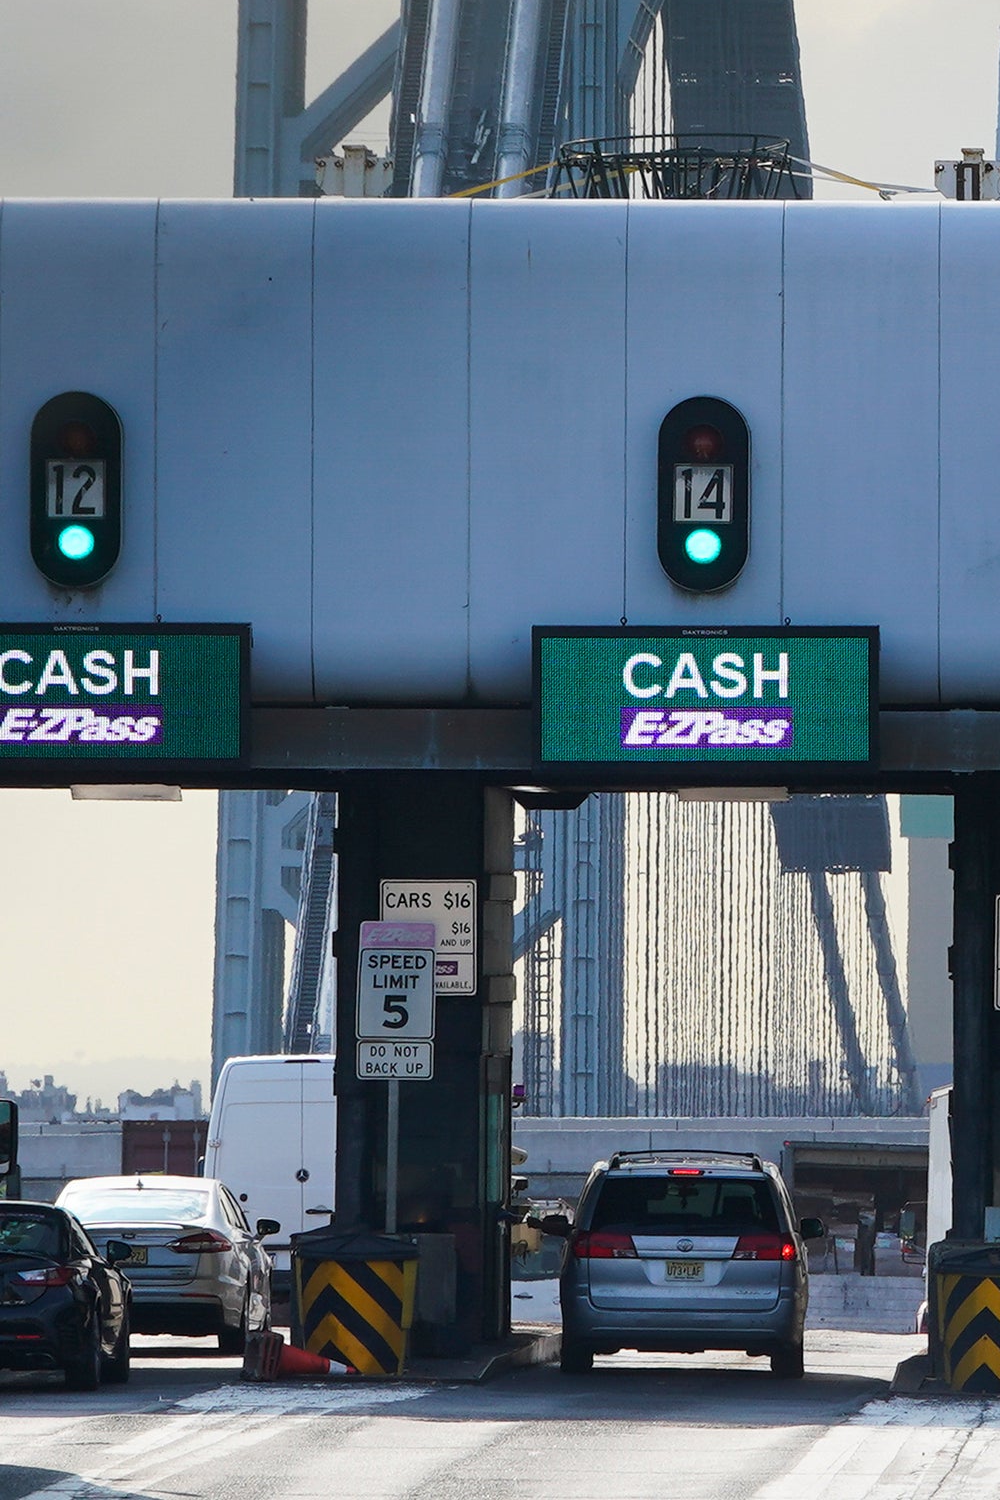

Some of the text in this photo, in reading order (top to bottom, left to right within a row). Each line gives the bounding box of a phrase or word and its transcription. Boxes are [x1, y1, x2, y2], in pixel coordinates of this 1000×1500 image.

[53, 464, 96, 515] 12
[681, 468, 725, 519] 14
[0, 649, 160, 696] CASH
[622, 652, 789, 699] CASH
[385, 890, 471, 910] CARS $16
[451, 921, 471, 935] $16
[440, 939, 471, 947] AND UP
[368, 955, 427, 969] SPEED
[373, 974, 419, 989] LIMIT
[382, 995, 409, 1029] 5
[370, 1046, 419, 1057] DO NOT
[365, 1062, 424, 1074] BACK UP
